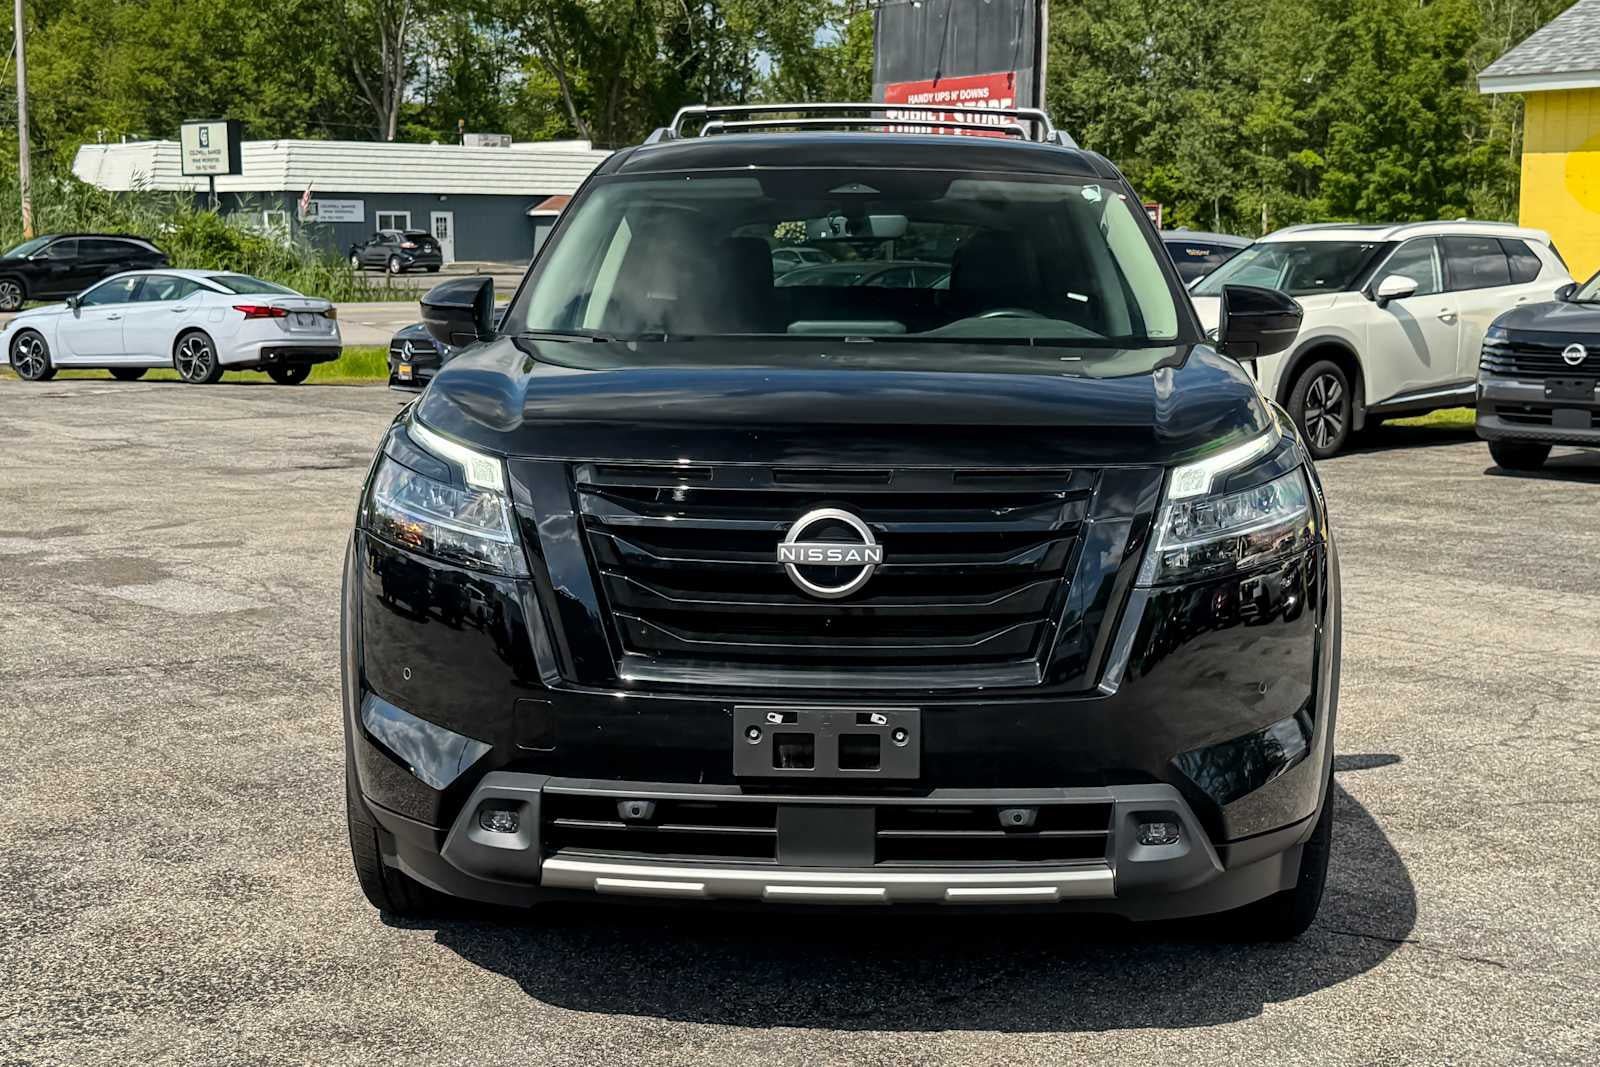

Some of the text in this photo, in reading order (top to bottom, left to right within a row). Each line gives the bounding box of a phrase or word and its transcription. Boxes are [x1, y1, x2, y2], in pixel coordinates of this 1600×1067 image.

[908, 93, 934, 104] HANDY
[935, 91, 951, 102] UPS
[960, 88, 989, 100] DOWNS
[780, 547, 880, 562] NISSAN
